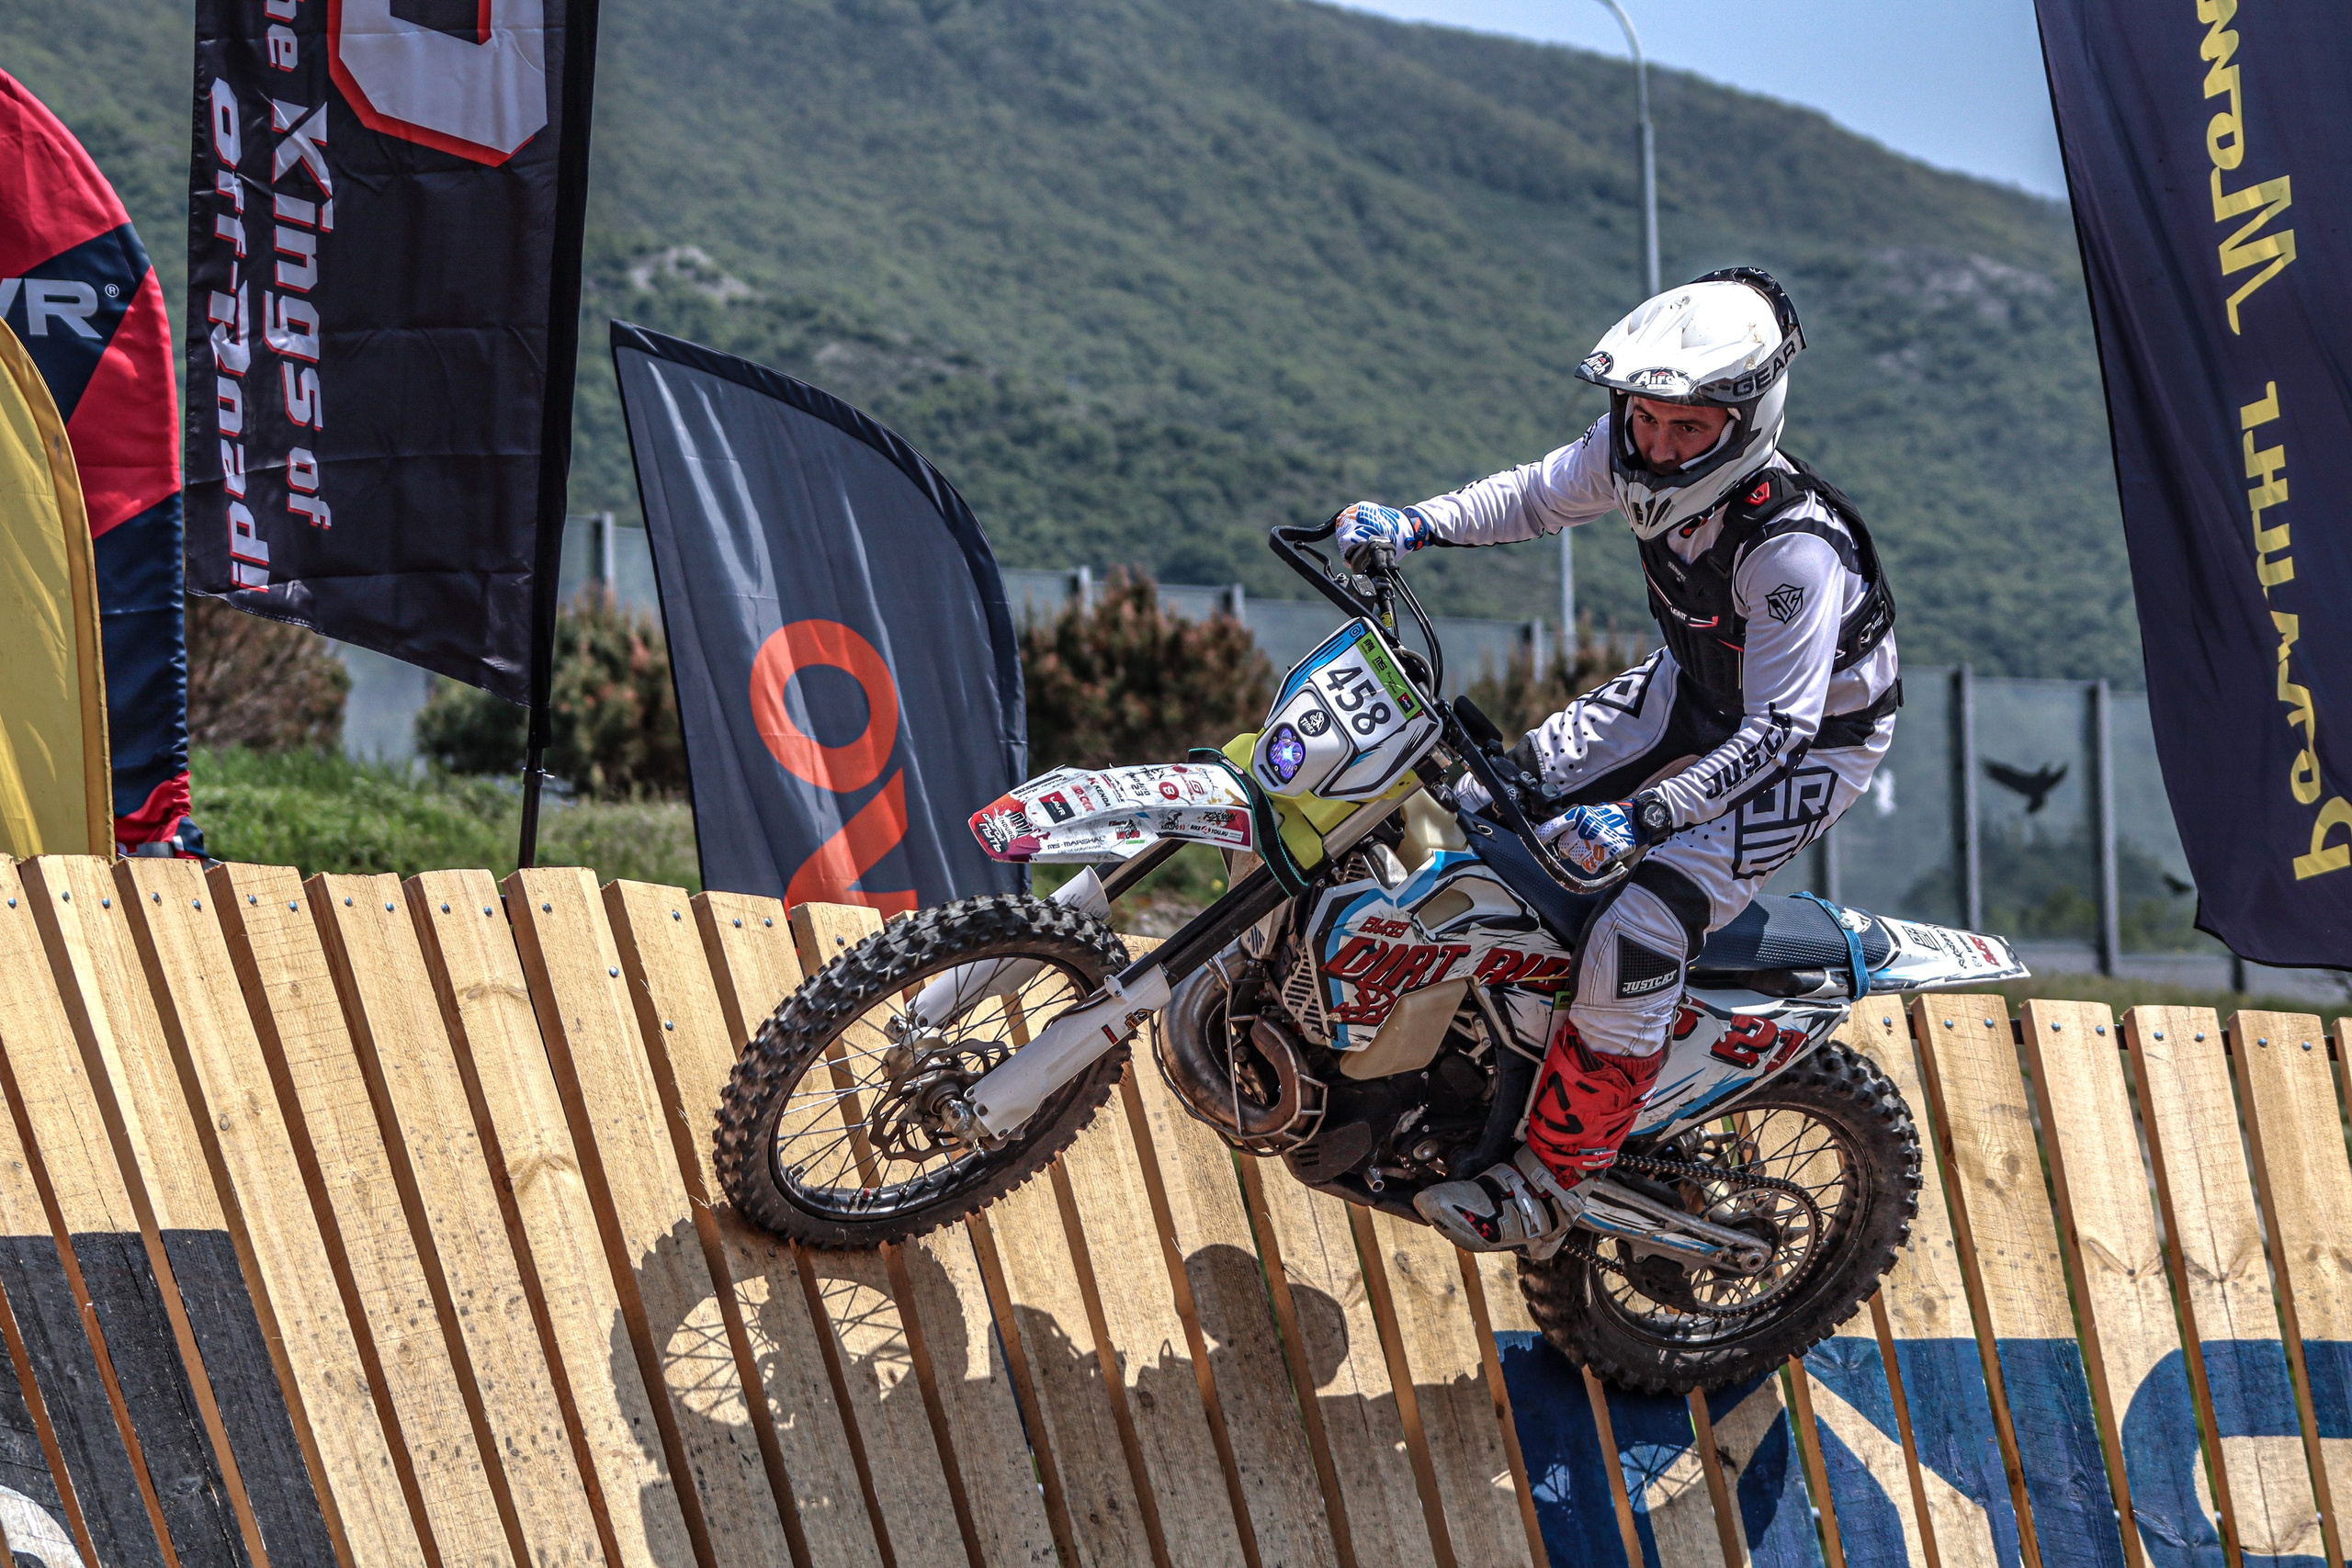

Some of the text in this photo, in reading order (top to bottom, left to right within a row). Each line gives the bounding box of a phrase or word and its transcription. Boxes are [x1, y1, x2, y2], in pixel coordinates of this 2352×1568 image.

[264, 99, 334, 431] Kings
[209, 77, 271, 592] Off-Road!
[287, 446, 332, 530] of
[1326, 666, 1392, 735] 458
[1299, 716, 1316, 735] TIREX
[1092, 784, 1112, 807] KENDA
[1131, 784, 1145, 797] 23
[1048, 795, 1067, 817] LAVR
[978, 822, 1003, 853] ПУТЬ
[997, 816, 1016, 840] ENDURO
[1318, 935, 1471, 992] DIRT
[1623, 968, 1678, 992] JUSTCAT
